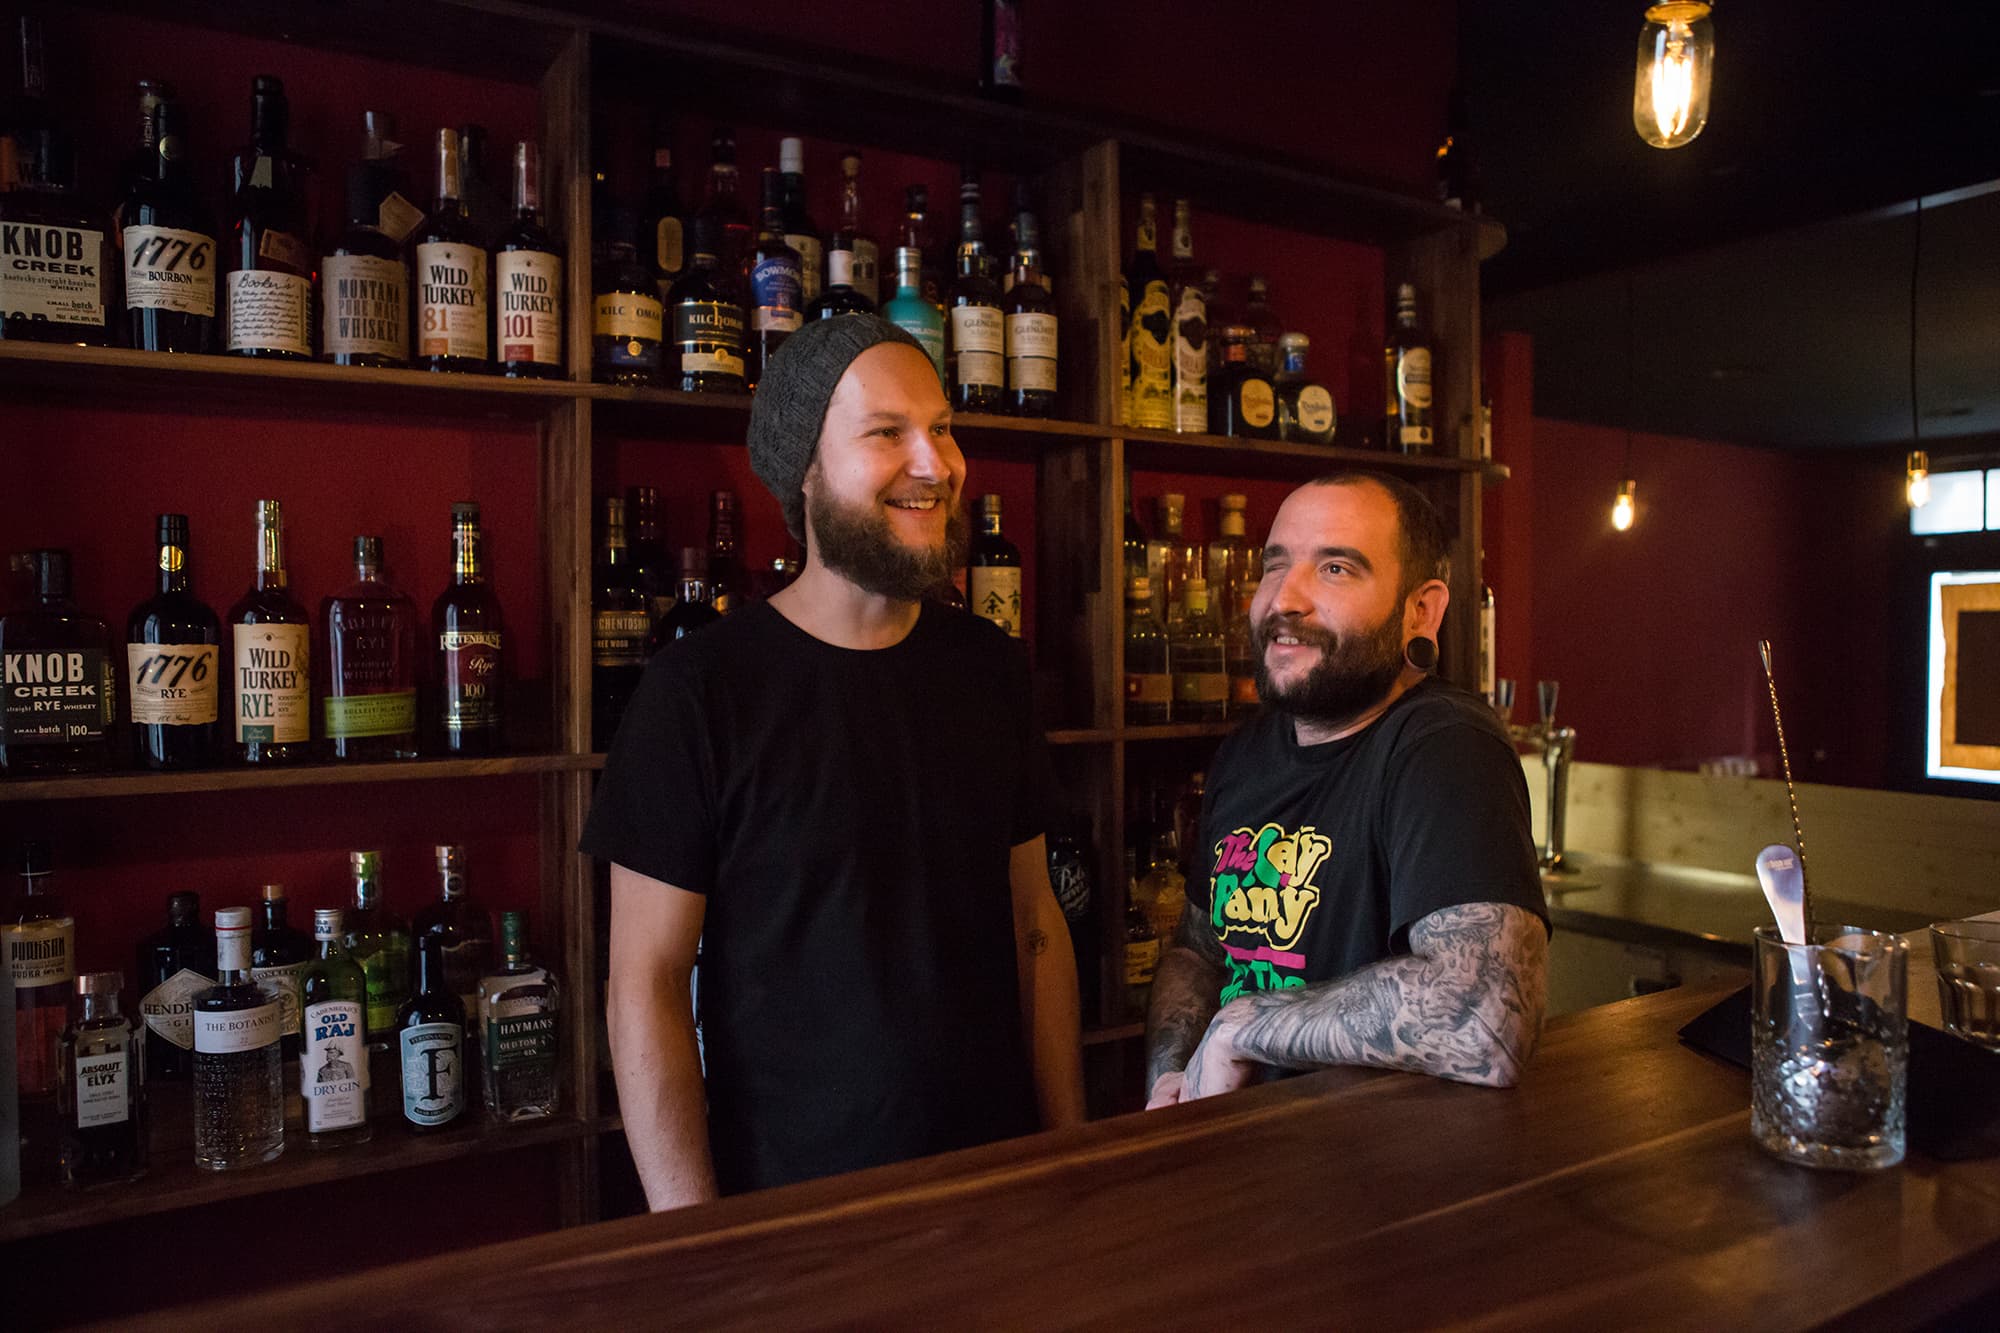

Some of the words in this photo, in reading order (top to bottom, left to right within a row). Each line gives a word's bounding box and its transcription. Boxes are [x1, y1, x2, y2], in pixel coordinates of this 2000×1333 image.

[3, 225, 83, 260] KNOB
[132, 235, 210, 271] 1776
[13, 260, 95, 276] CREEK
[148, 271, 193, 284] BOURBON
[430, 265, 468, 286] WILD
[511, 272, 547, 294] WILD
[422, 283, 476, 306] TURKEY
[503, 290, 554, 314] TURKEY
[423, 307, 448, 332] 81
[504, 314, 534, 338] 101
[440, 634, 502, 651] RTTENHOUSE
[4, 652, 85, 684] KNOB
[248, 648, 290, 669] WILD
[469, 656, 495, 677] Rye
[136, 651, 212, 688] 1776
[240, 667, 298, 690] TURKEY
[14, 684, 97, 698] CREEK
[160, 688, 187, 699] RYE
[463, 682, 486, 698] 100
[33, 700, 61, 711] RYE
[241, 693, 275, 719] RYE
[69, 724, 88, 736] 100
[1215, 832, 1258, 873] The
[206, 1022, 227, 1032] THE
[321, 1013, 348, 1024] OLD
[315, 1023, 356, 1042] RAJ
[80, 1061, 123, 1076] ABSOLUT
[87, 1073, 116, 1087] ELYX
[313, 1085, 337, 1097] DRY
[338, 1080, 361, 1093] GIN
